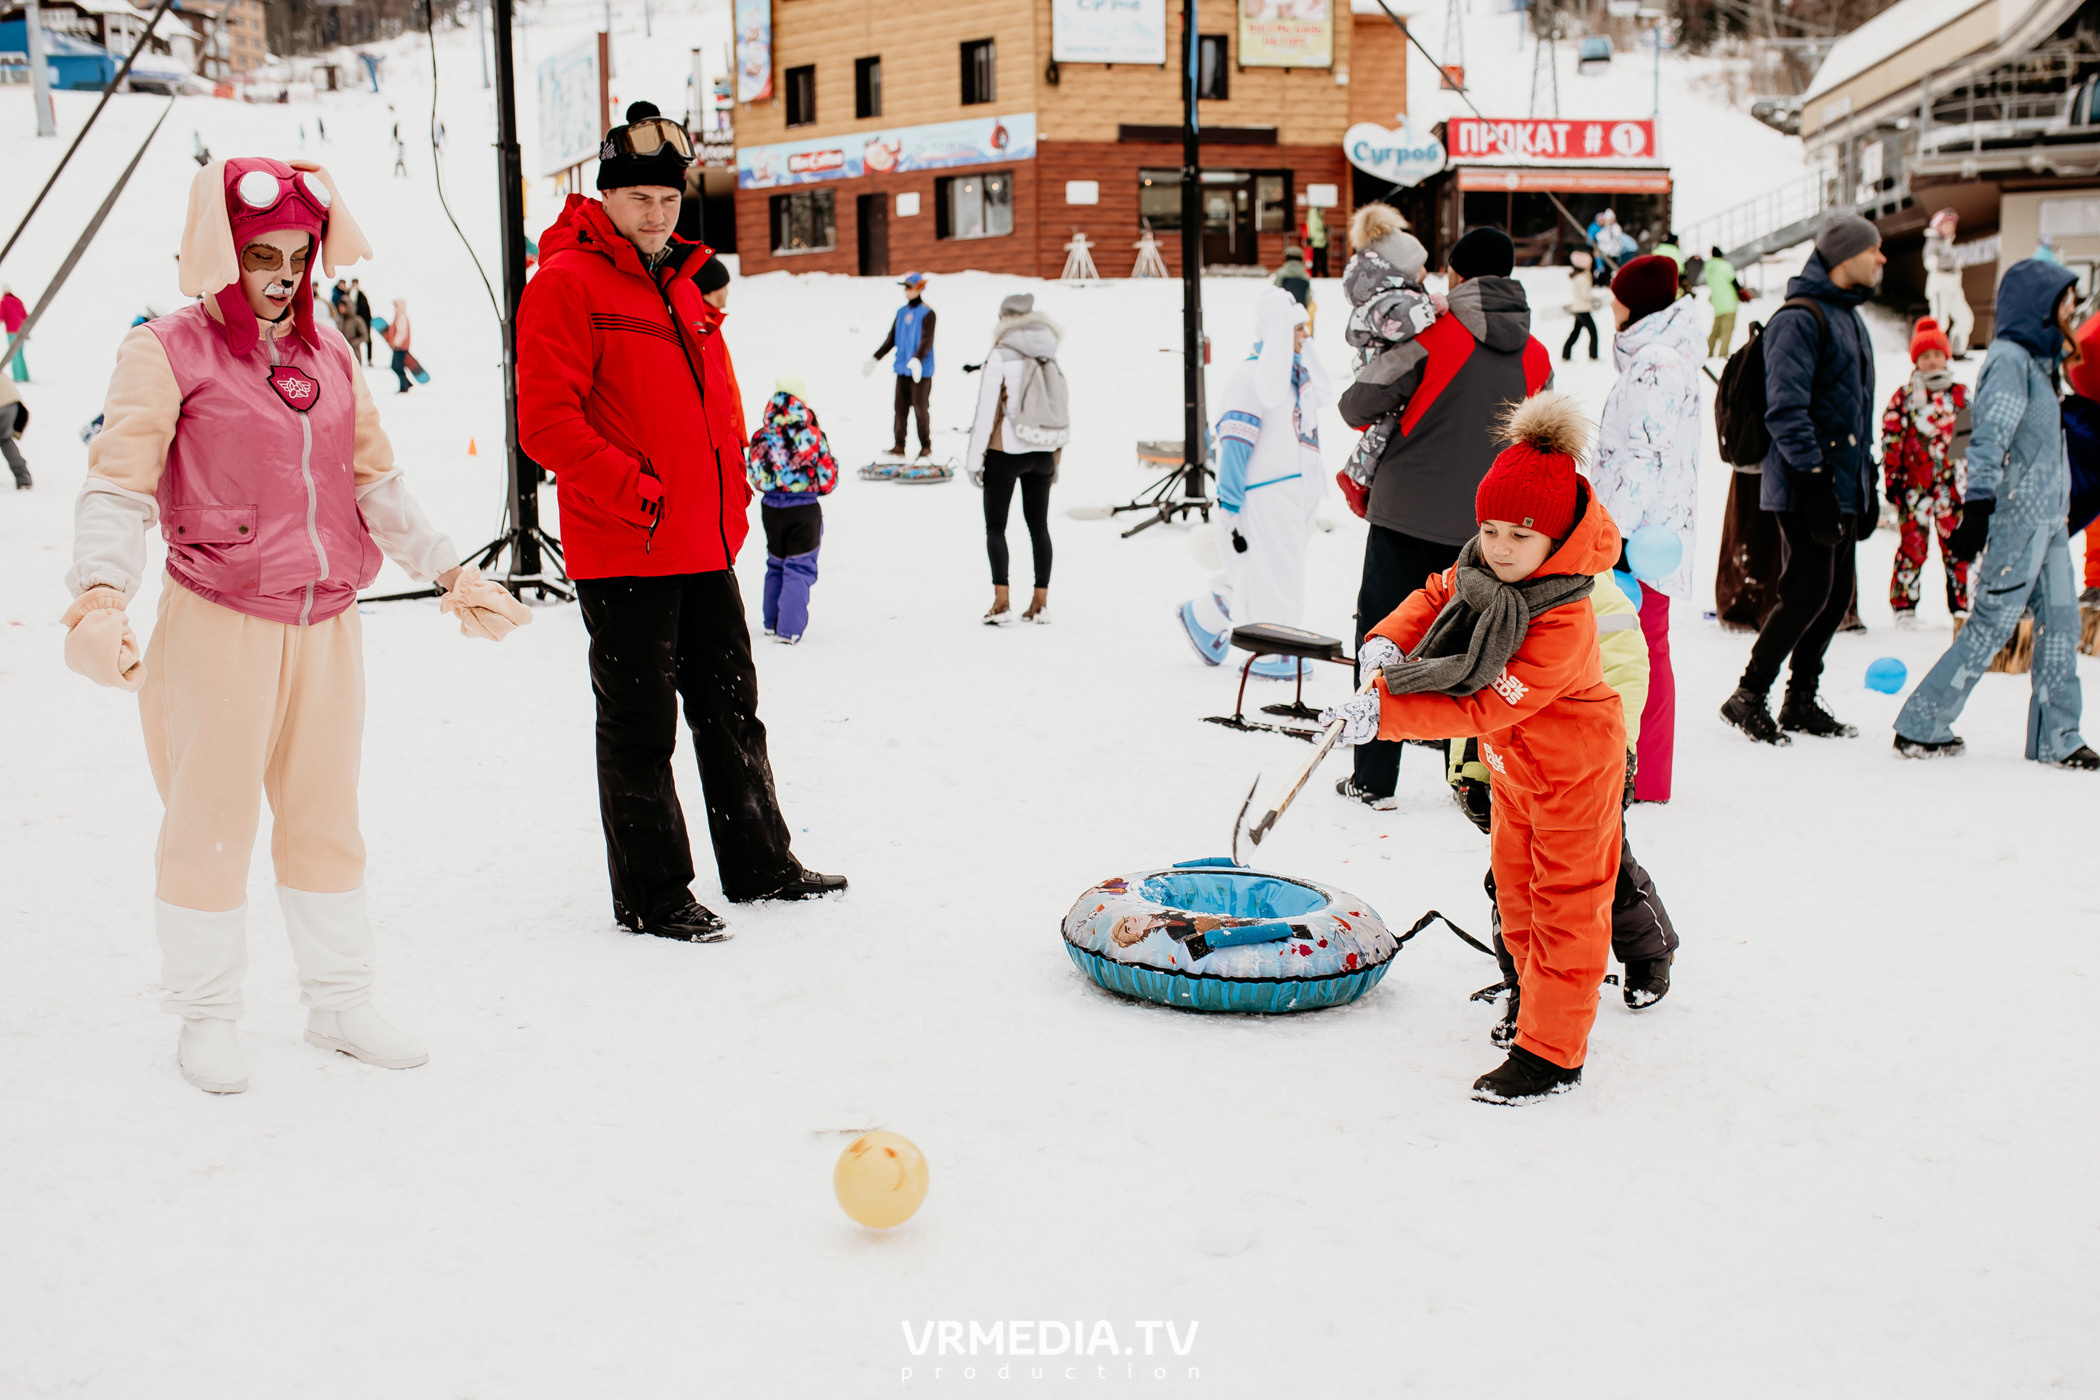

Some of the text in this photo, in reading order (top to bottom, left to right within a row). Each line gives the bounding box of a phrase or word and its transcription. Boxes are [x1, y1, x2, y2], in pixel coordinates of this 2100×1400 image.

[1354, 140, 1438, 166] Сугроб
[1459, 122, 1571, 154] ПРОКАТ
[1490, 675, 1521, 705] IDS
[1500, 666, 1529, 698] ASK
